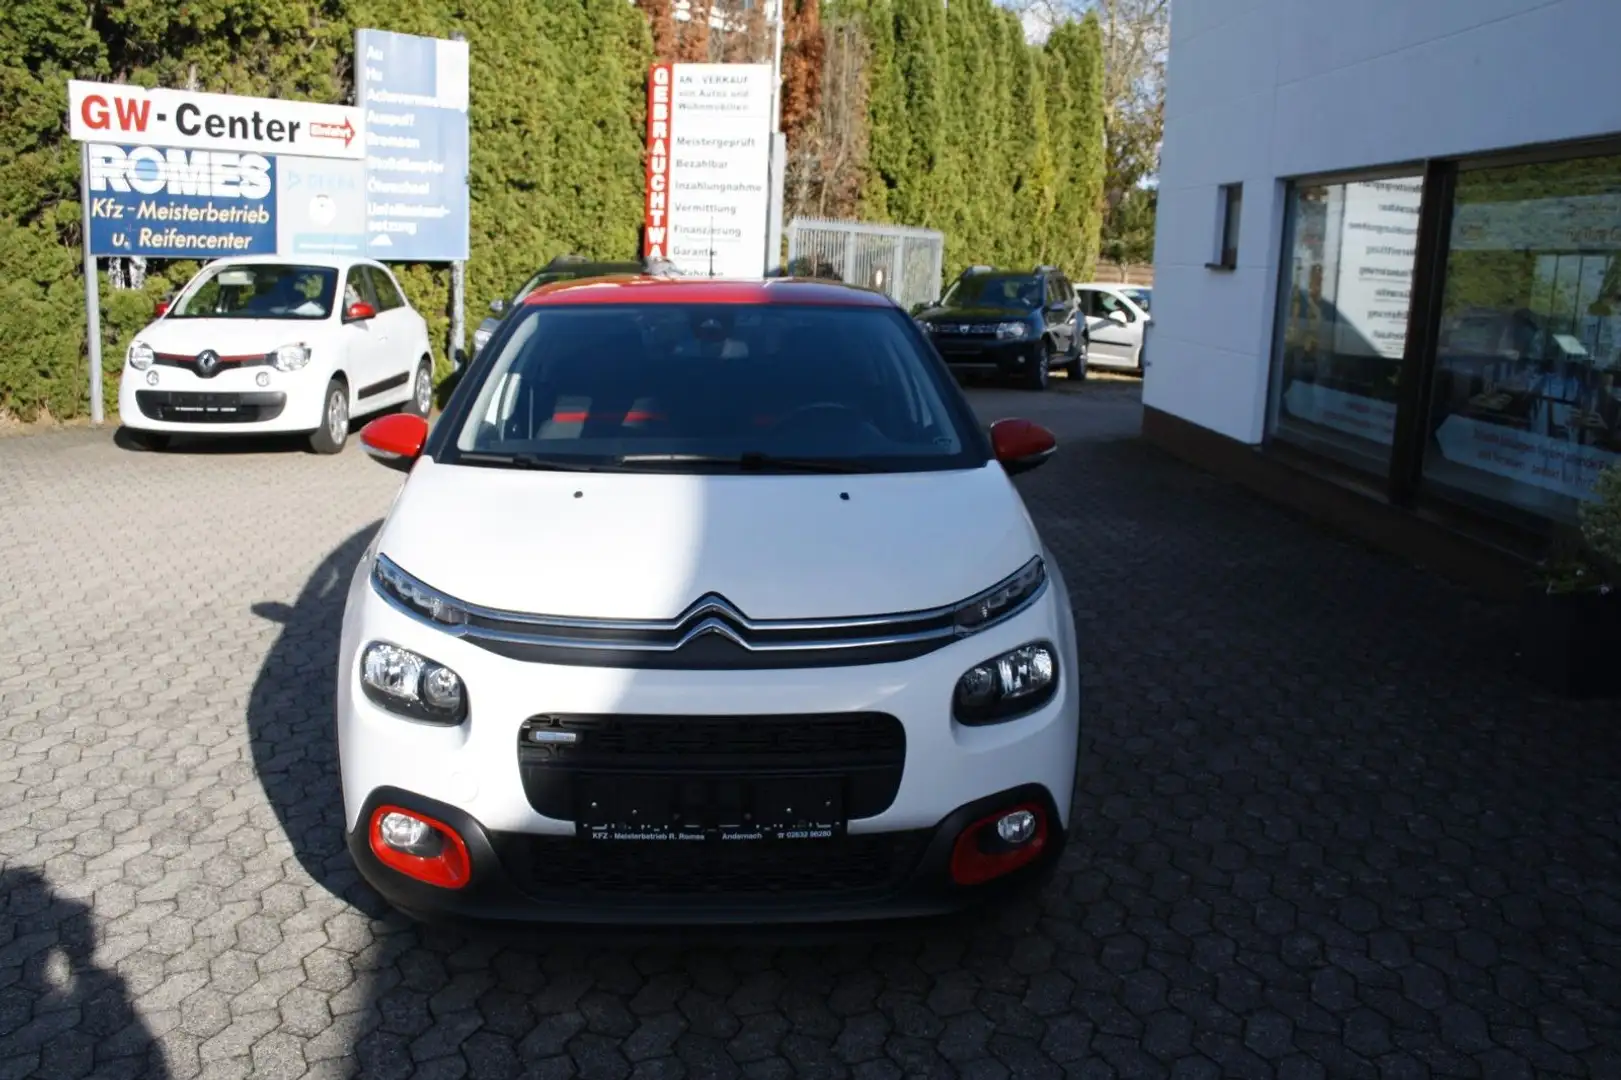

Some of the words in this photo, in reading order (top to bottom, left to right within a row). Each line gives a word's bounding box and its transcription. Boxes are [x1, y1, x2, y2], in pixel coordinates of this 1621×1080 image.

[175, 103, 301, 142] Center
[676, 137, 756, 148] Meistergeprüft
[676, 159, 728, 169] Bezahlbar
[89, 145, 271, 199] ROMES
[675, 182, 762, 193] Inzahlungnahme
[675, 204, 737, 215] Vermittlung
[139, 230, 252, 249] Reifencenter
[614, 832, 667, 841] Meisterbetrieb
[722, 832, 763, 841] Andernach
